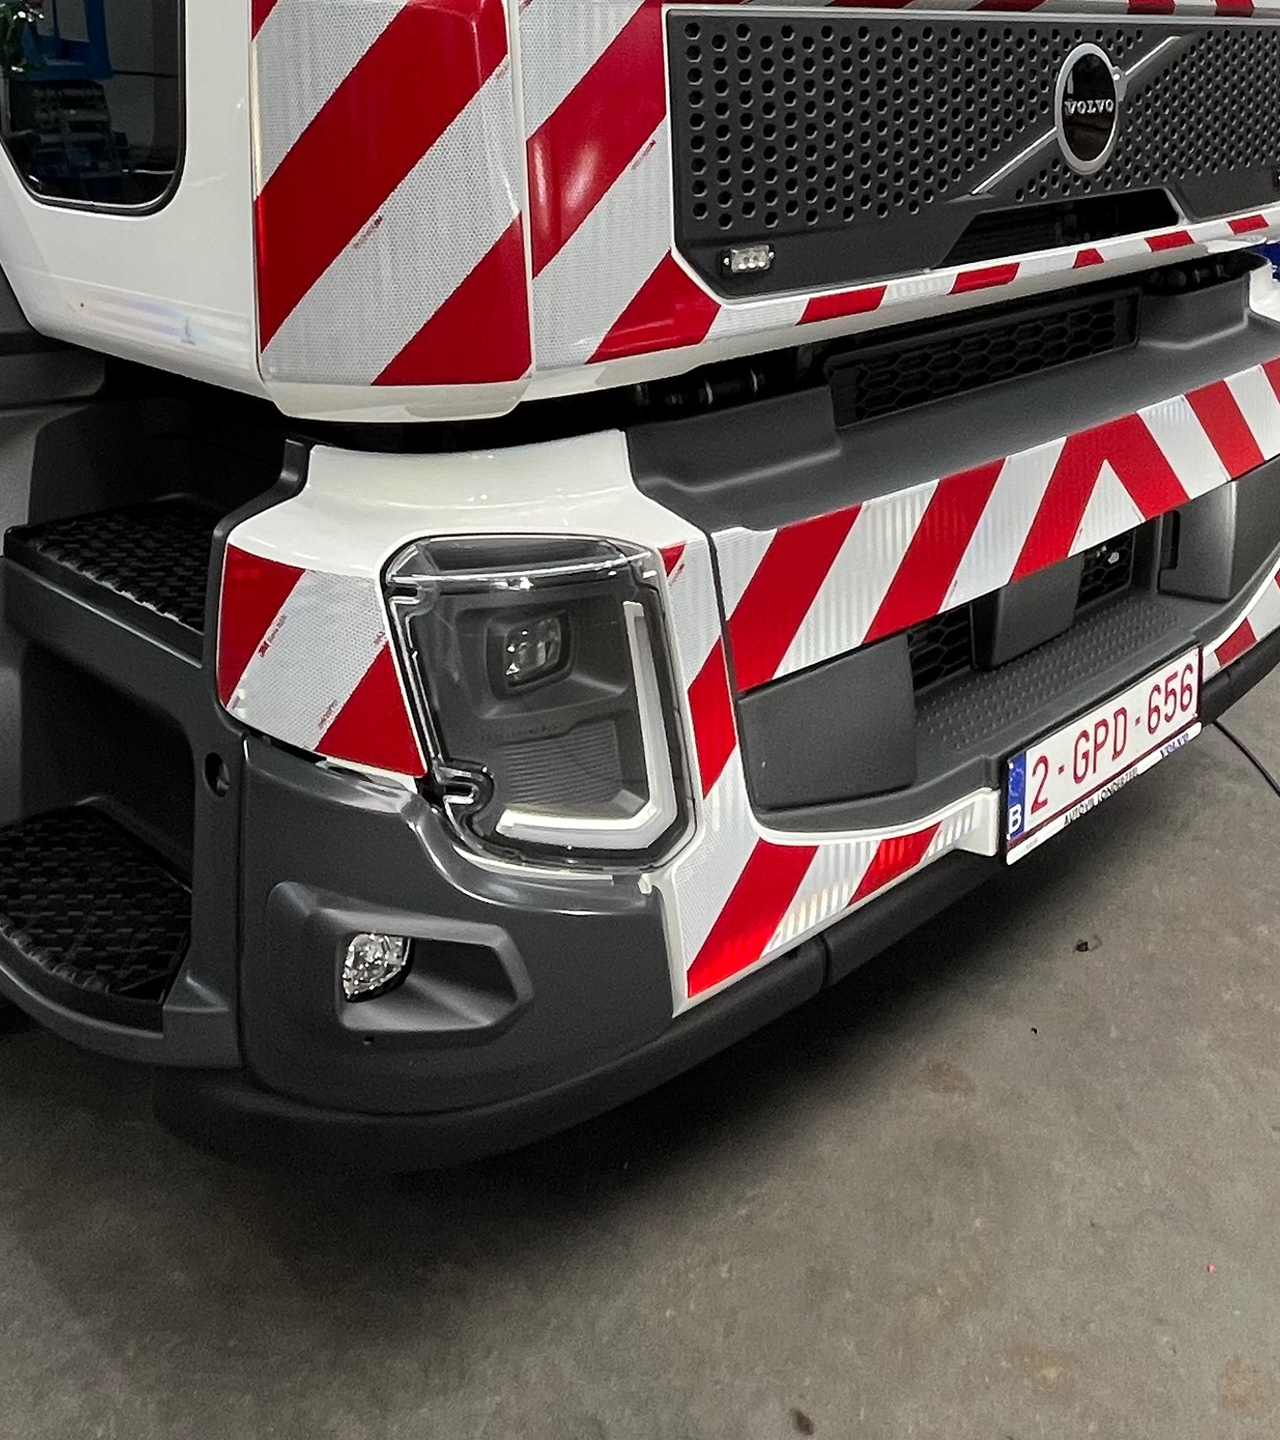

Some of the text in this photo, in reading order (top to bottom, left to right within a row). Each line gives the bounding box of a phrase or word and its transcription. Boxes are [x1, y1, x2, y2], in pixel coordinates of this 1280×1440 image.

[1063, 98, 1115, 115] VOLVO
[1029, 662, 1195, 816] 2-GPD-656
[1008, 802, 1023, 835] B
